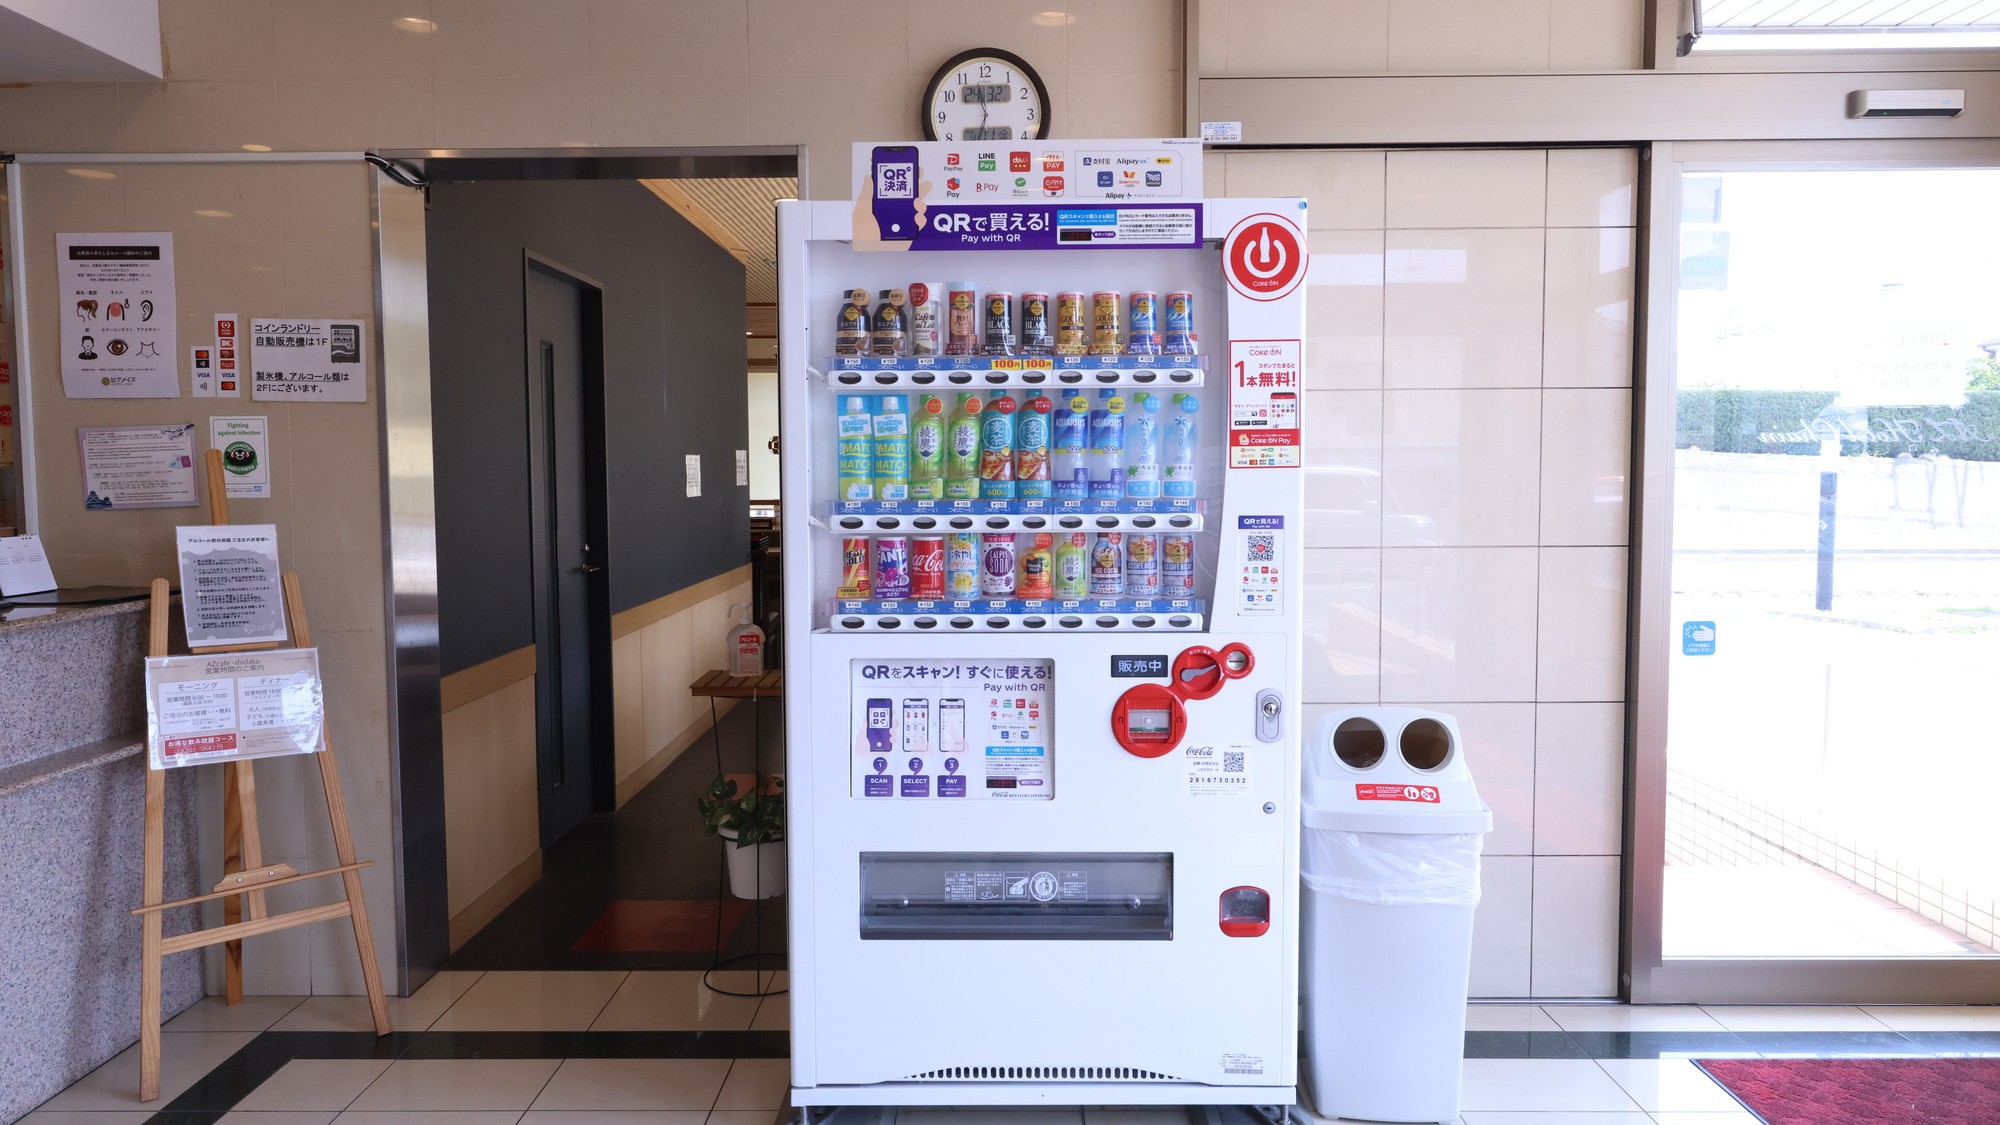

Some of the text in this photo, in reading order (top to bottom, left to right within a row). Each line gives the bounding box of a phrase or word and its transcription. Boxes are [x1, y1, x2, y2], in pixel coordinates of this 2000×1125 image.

[979, 66, 991, 78] 12
[1006, 71, 1011, 83] 1
[957, 73, 968, 85] 11
[944, 90, 955, 102] 10
[1020, 88, 1028, 100] 2
[938, 112, 946, 123] 9
[1026, 108, 1035, 121] 3
[883, 169, 907, 180] QR
[884, 181, 907, 192] 決済
[984, 183, 999, 192] Pay
[947, 191, 960, 199] Pay
[933, 212, 1049, 233] QRで買える!
[961, 234, 1021, 243] Pay with QR
[914, 313, 929, 321] Café
[254, 324, 321, 333] コインランドリー
[256, 336, 328, 346] 自動販売機は1F
[1269, 348, 1282, 356] ON
[994, 359, 1020, 368] 100円
[1025, 359, 1052, 368] 100円
[256, 372, 349, 381] 製氷機、アルコール類は
[256, 383, 324, 393] 2Fにございます。
[1055, 418, 1086, 427] AQUARIUS
[1092, 418, 1122, 428] AQUARIUS
[919, 425, 931, 449] 綾鷹
[957, 425, 969, 449] 綾鷹
[990, 421, 1004, 446] 麦茶
[1026, 421, 1041, 446] 麦茶
[844, 548, 863, 559] REAL
[877, 548, 907, 563] FANTA
[950, 550, 975, 559] 冷やし
[989, 550, 1008, 559] CALPIS
[844, 555, 864, 567] GOLD
[989, 558, 1009, 573] SODA
[205, 665, 264, 674] 営業時間のご案内
[1118, 659, 1163, 673] 販売中
[861, 664, 1052, 680] QRをスキャン! すぐに使える!
[260, 677, 289, 685] ディナー
[177, 682, 218, 691] モーニング
[984, 683, 1046, 693] Pay with QR
[166, 694, 192, 703] 営業時間
[167, 735, 234, 748] お得な飲み放題コース
[1185, 746, 1214, 756] Coca-Cola
